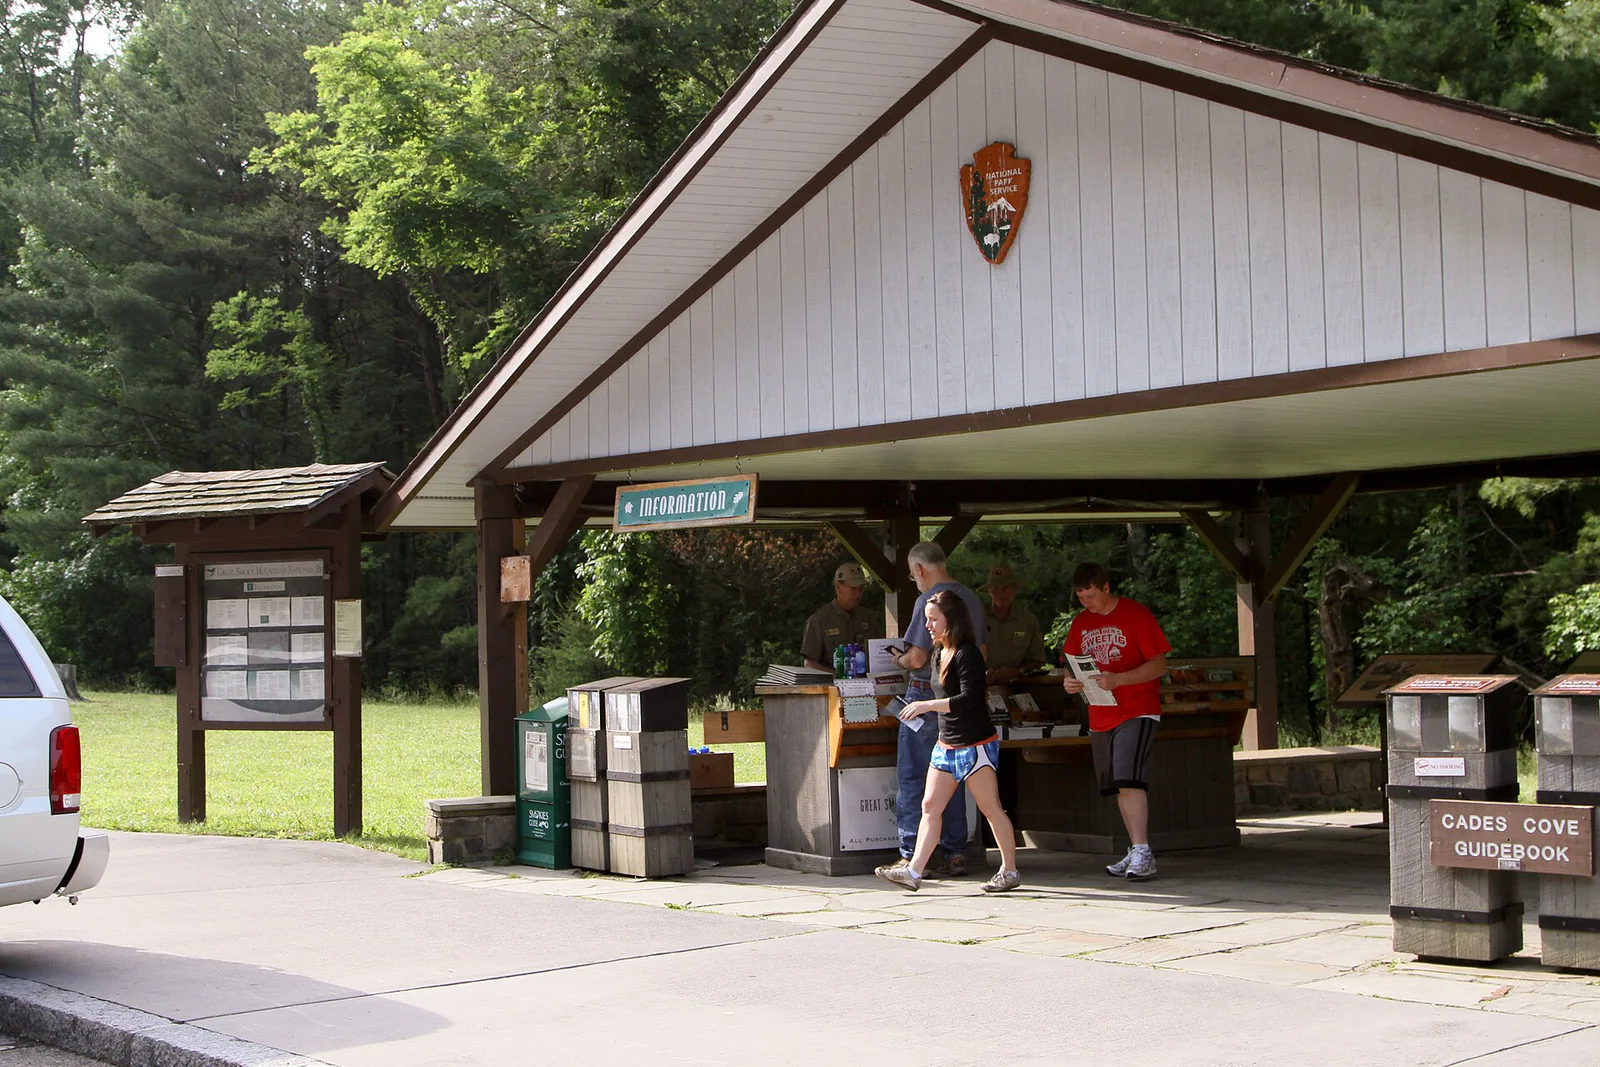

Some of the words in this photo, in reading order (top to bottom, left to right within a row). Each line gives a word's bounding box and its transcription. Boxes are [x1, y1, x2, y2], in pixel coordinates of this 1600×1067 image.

[986, 168, 1022, 179] NATIONAL
[994, 178, 1013, 186] PARK
[990, 185, 1018, 195] SERVICE
[639, 490, 726, 517] INFORMATION
[1082, 635, 1111, 653] SWEET
[1114, 634, 1127, 646] 16
[860, 799, 881, 812] GREAT
[884, 798, 897, 811] SM
[528, 809, 549, 820] SMOKIES
[1441, 813, 1507, 832] CADES
[1523, 817, 1579, 836] COVE
[1454, 840, 1569, 862] GUIDEBOOK
